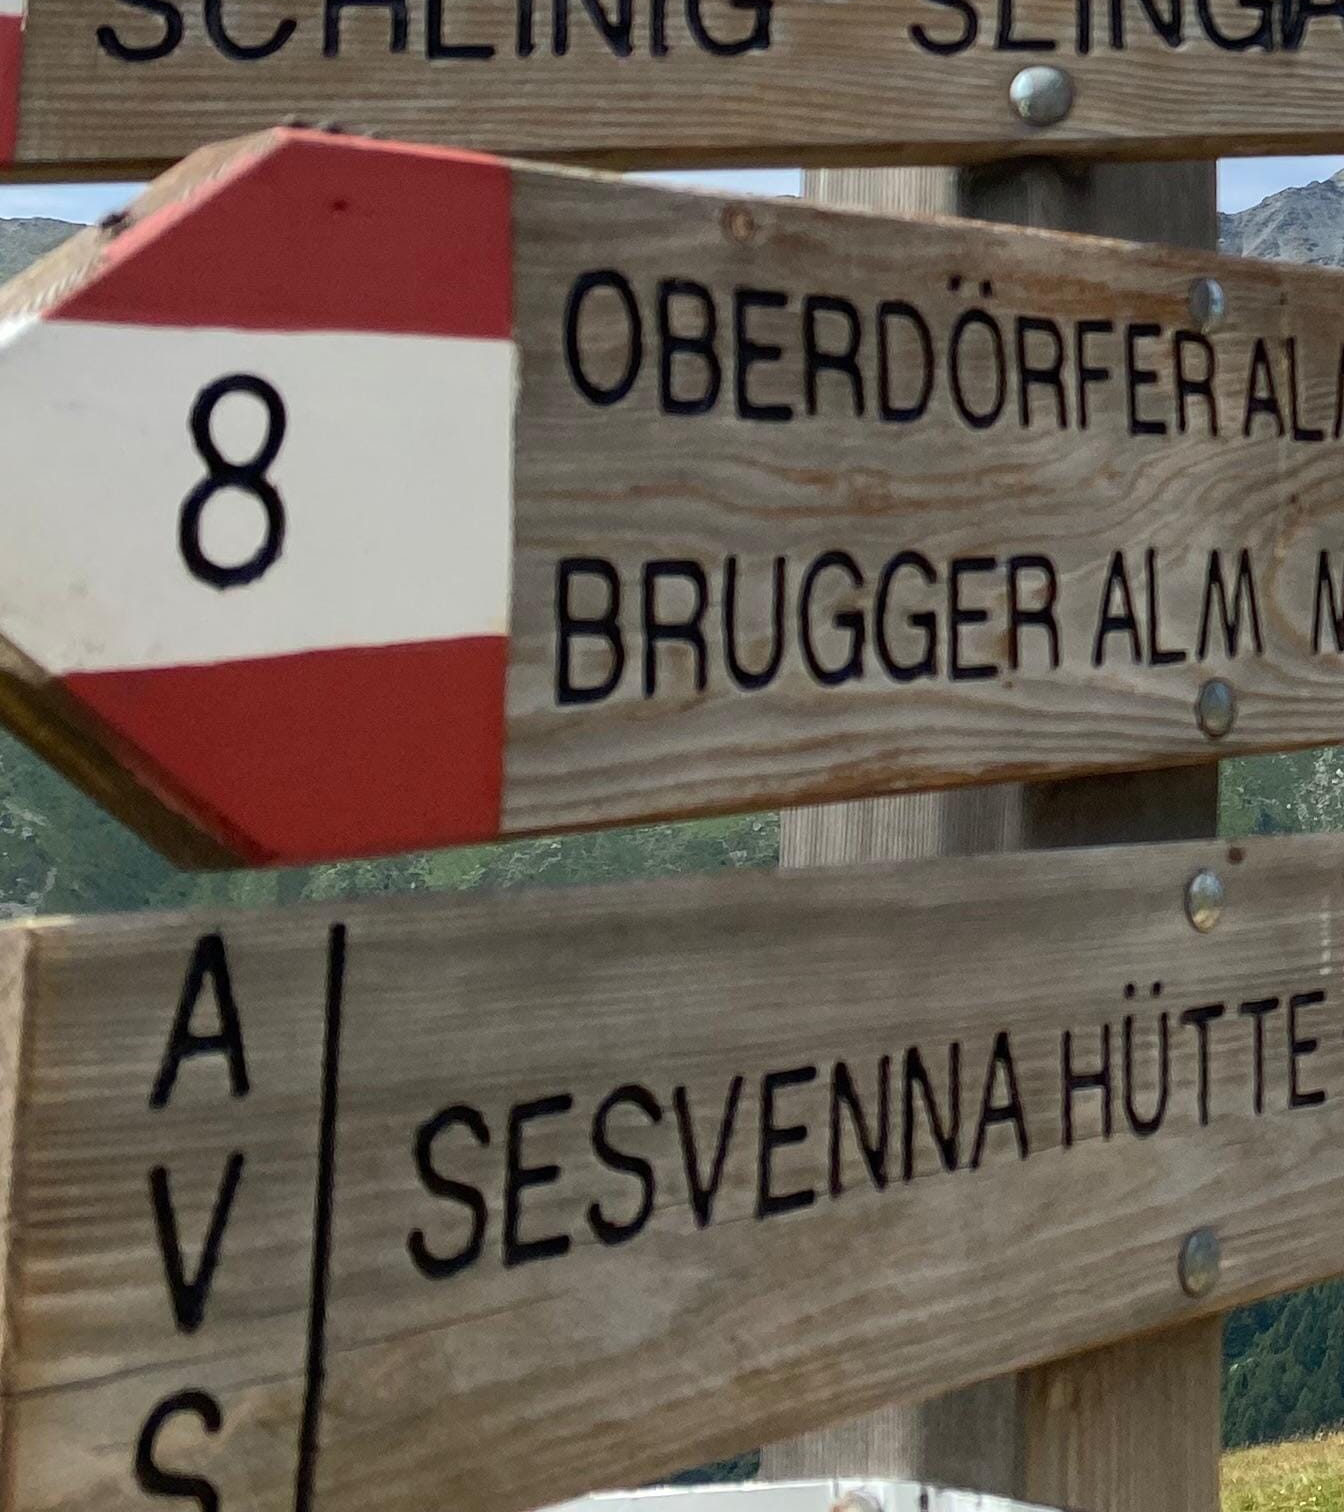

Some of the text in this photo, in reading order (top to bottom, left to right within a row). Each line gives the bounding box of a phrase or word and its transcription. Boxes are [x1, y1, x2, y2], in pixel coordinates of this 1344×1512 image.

[178, 372, 288, 591] 8
[552, 546, 1062, 708] BRUGGER
[1092, 545, 1265, 669] ALM
[404, 1029, 1031, 1283] SESVENNA
